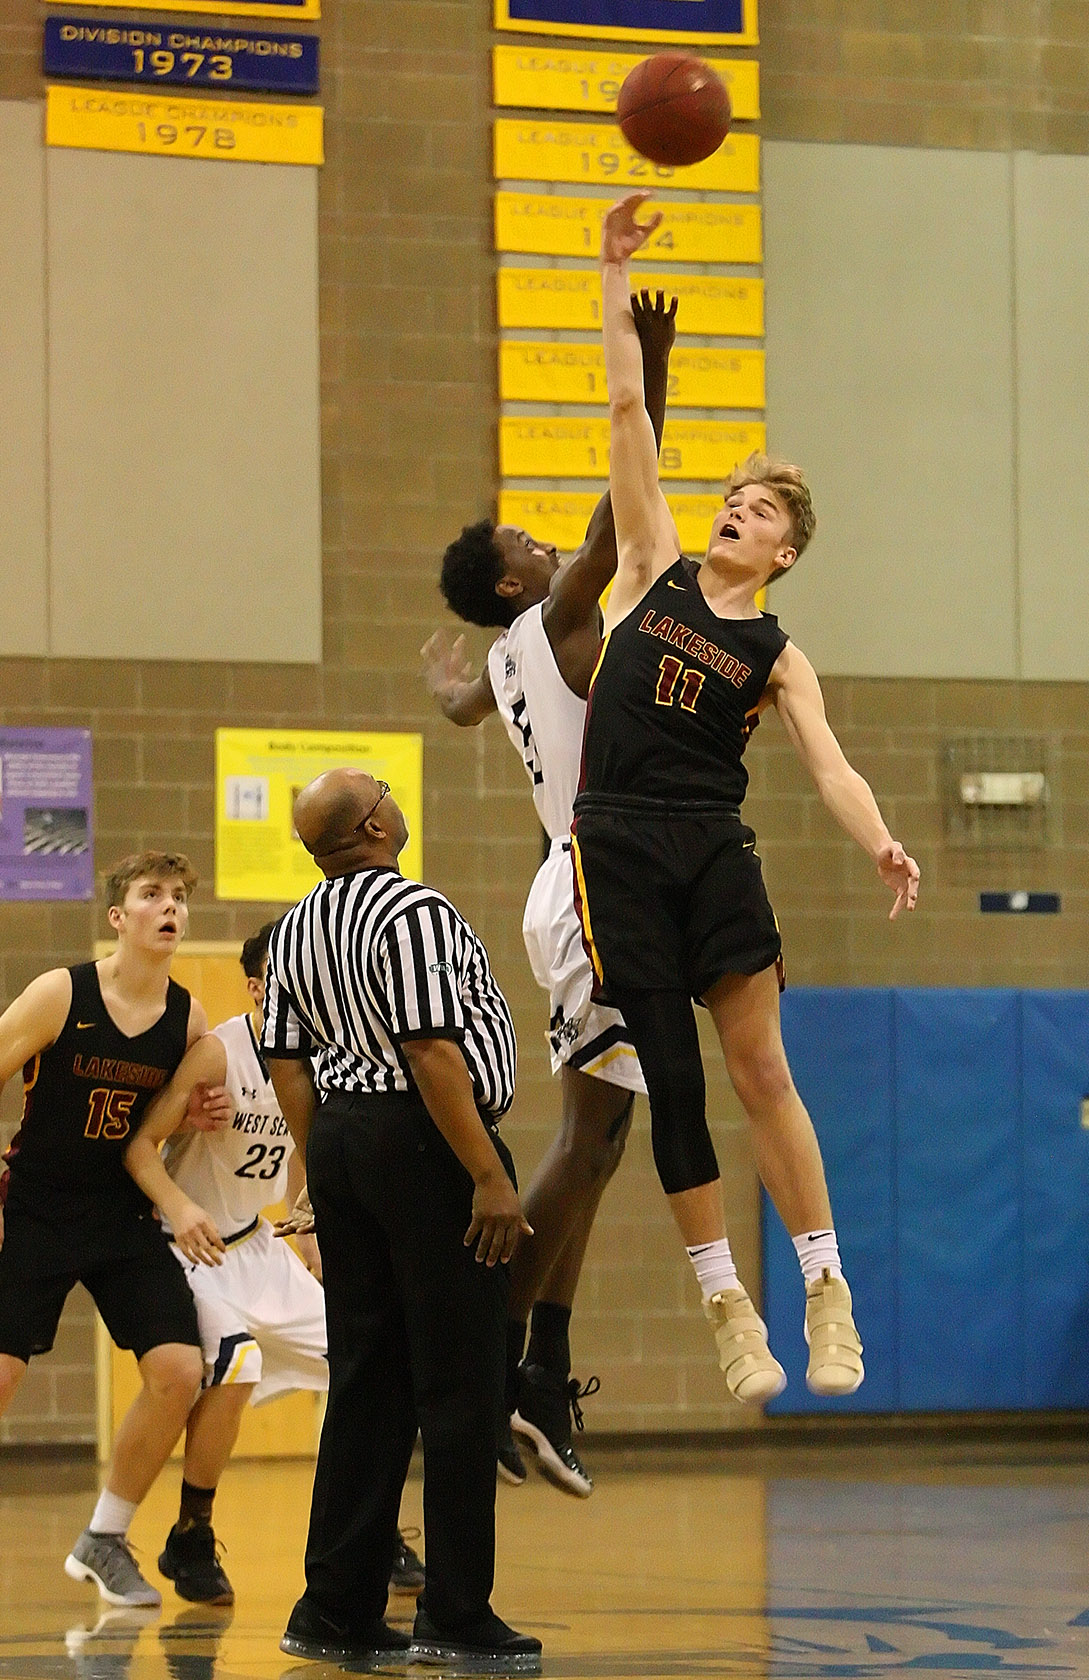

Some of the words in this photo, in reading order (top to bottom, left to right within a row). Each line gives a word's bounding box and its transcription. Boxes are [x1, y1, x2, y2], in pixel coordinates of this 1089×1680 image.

[59, 25, 162, 47] DIVISION
[168, 33, 304, 59] CHAMPIONS
[132, 49, 234, 81] 1973
[515, 57, 598, 75] LEAGUE
[70, 98, 153, 120] LEAGUE
[166, 104, 299, 129] CHAMPIONS
[136, 121, 237, 150] 1978
[582, 226, 675, 251] 14
[586, 372, 681, 397] 12
[588, 446, 683, 470] 18
[639, 609, 752, 688] LAKESIDE
[655, 654, 706, 714] 11
[72, 1053, 168, 1088] LAKESIDE
[84, 1087, 138, 1140] 15
[232, 1111, 270, 1135] WEST
[234, 1143, 286, 1180] 23
